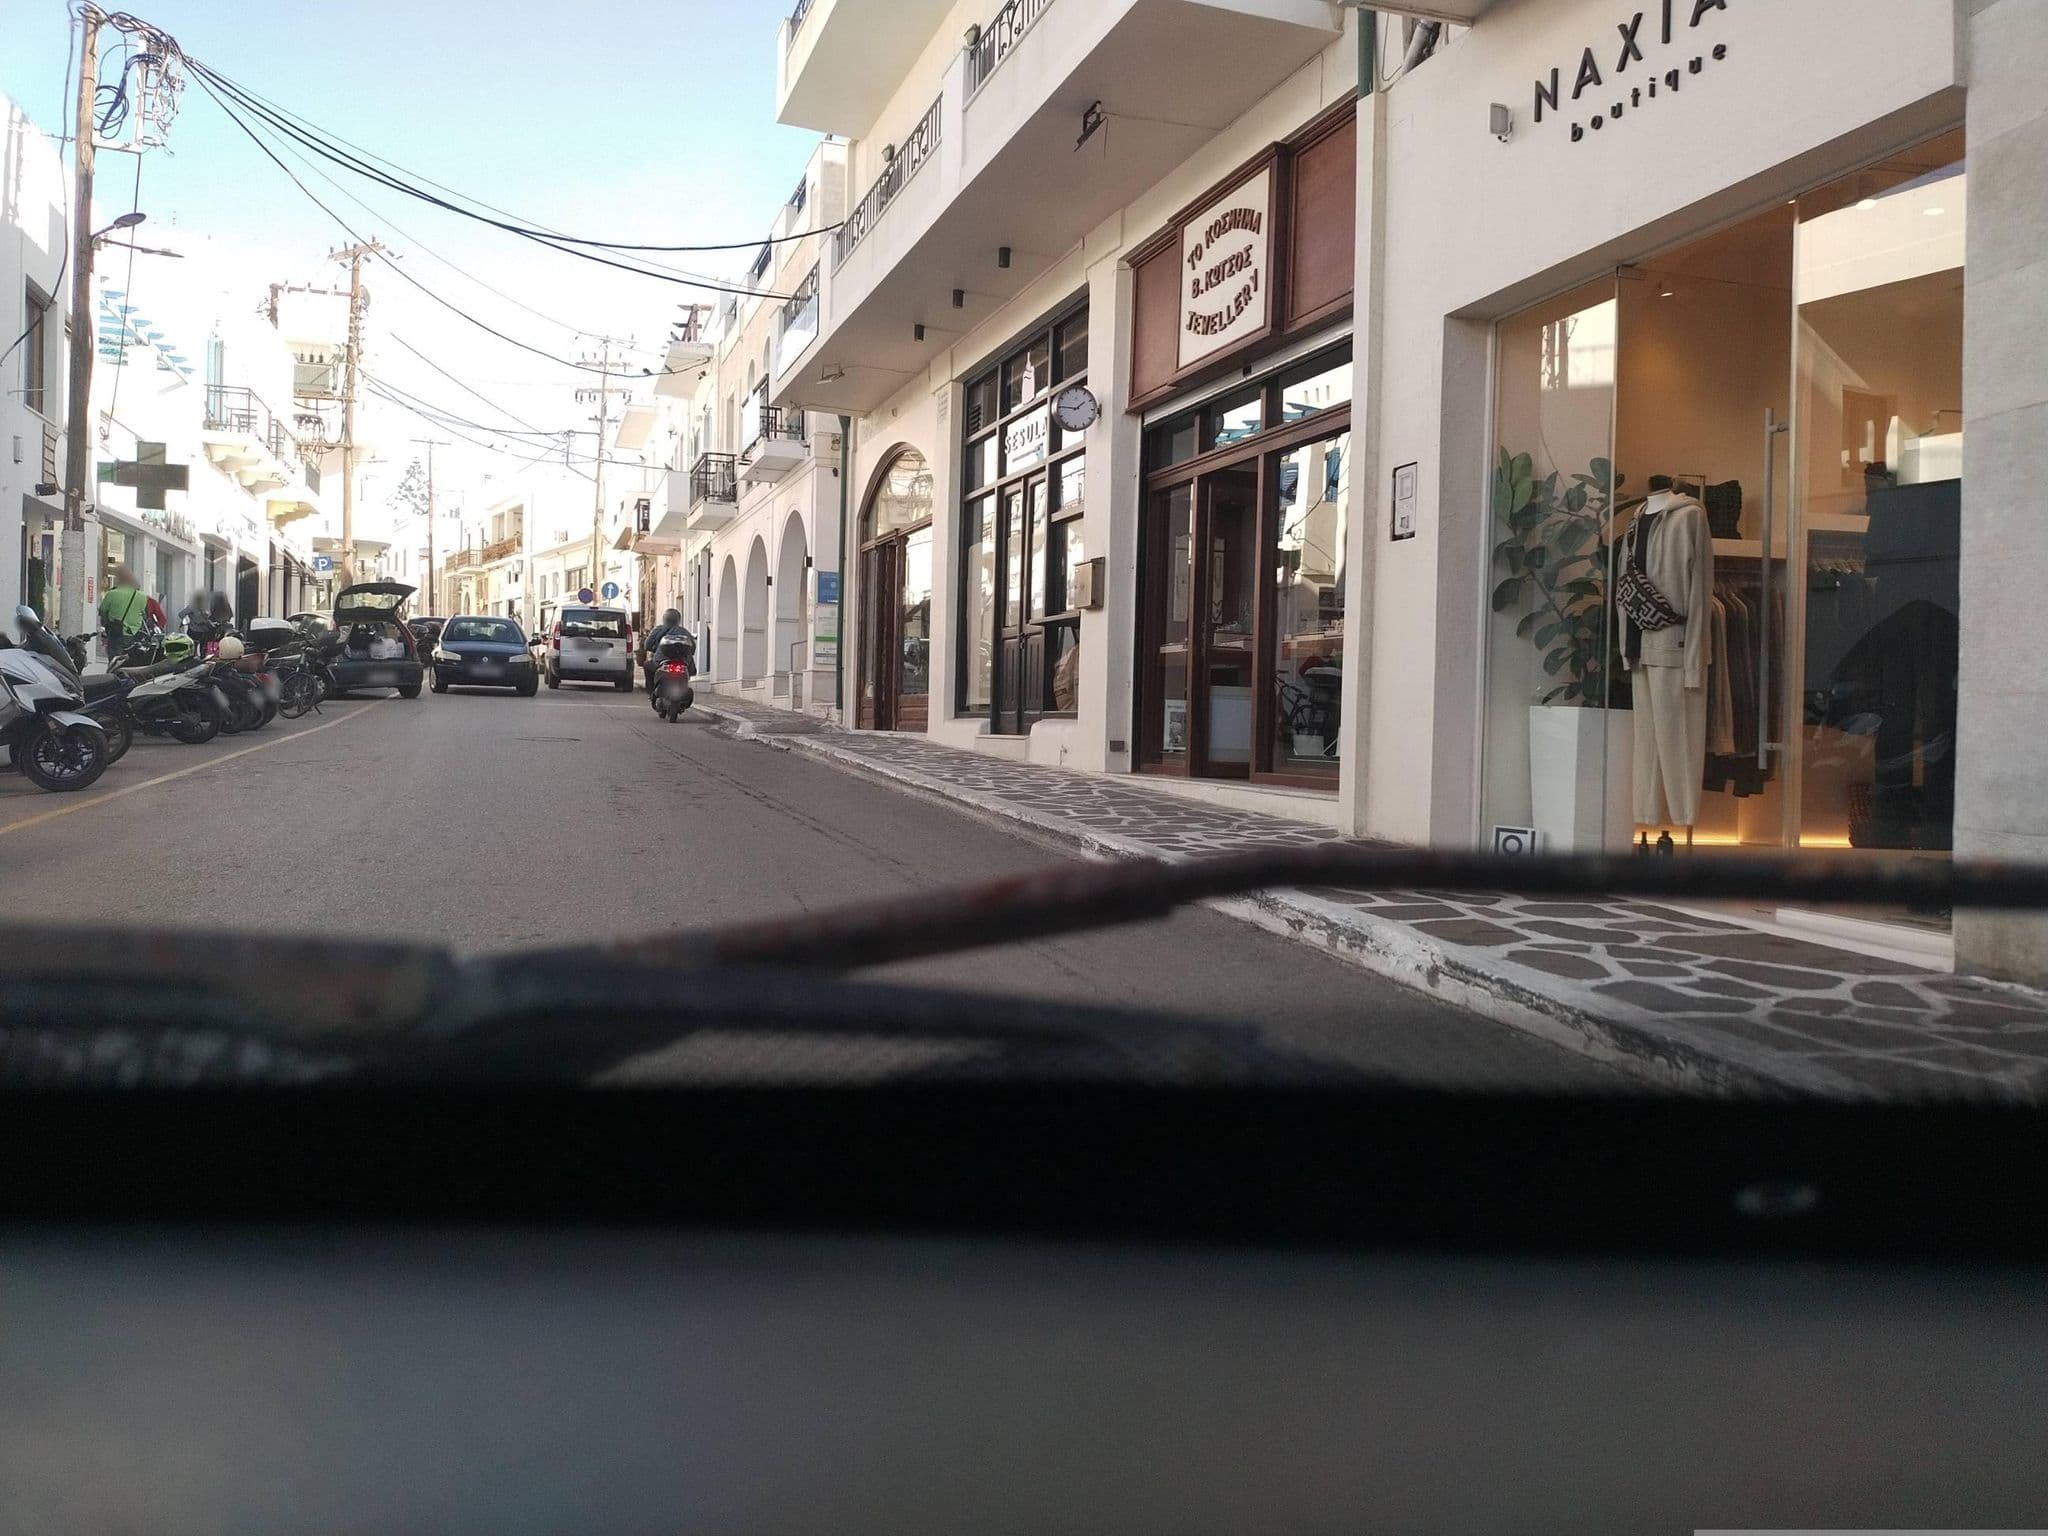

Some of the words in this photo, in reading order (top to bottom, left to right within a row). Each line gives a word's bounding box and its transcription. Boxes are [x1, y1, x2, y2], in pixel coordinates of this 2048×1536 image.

[1570, 44, 1727, 142] boutique
[1187, 243, 1203, 271] ΤΟ
[1205, 208, 1262, 249] ΚΟΣΜΗΜΑ
[1186, 268, 1259, 335] JEWELLERY
[318, 558, 328, 571] P
